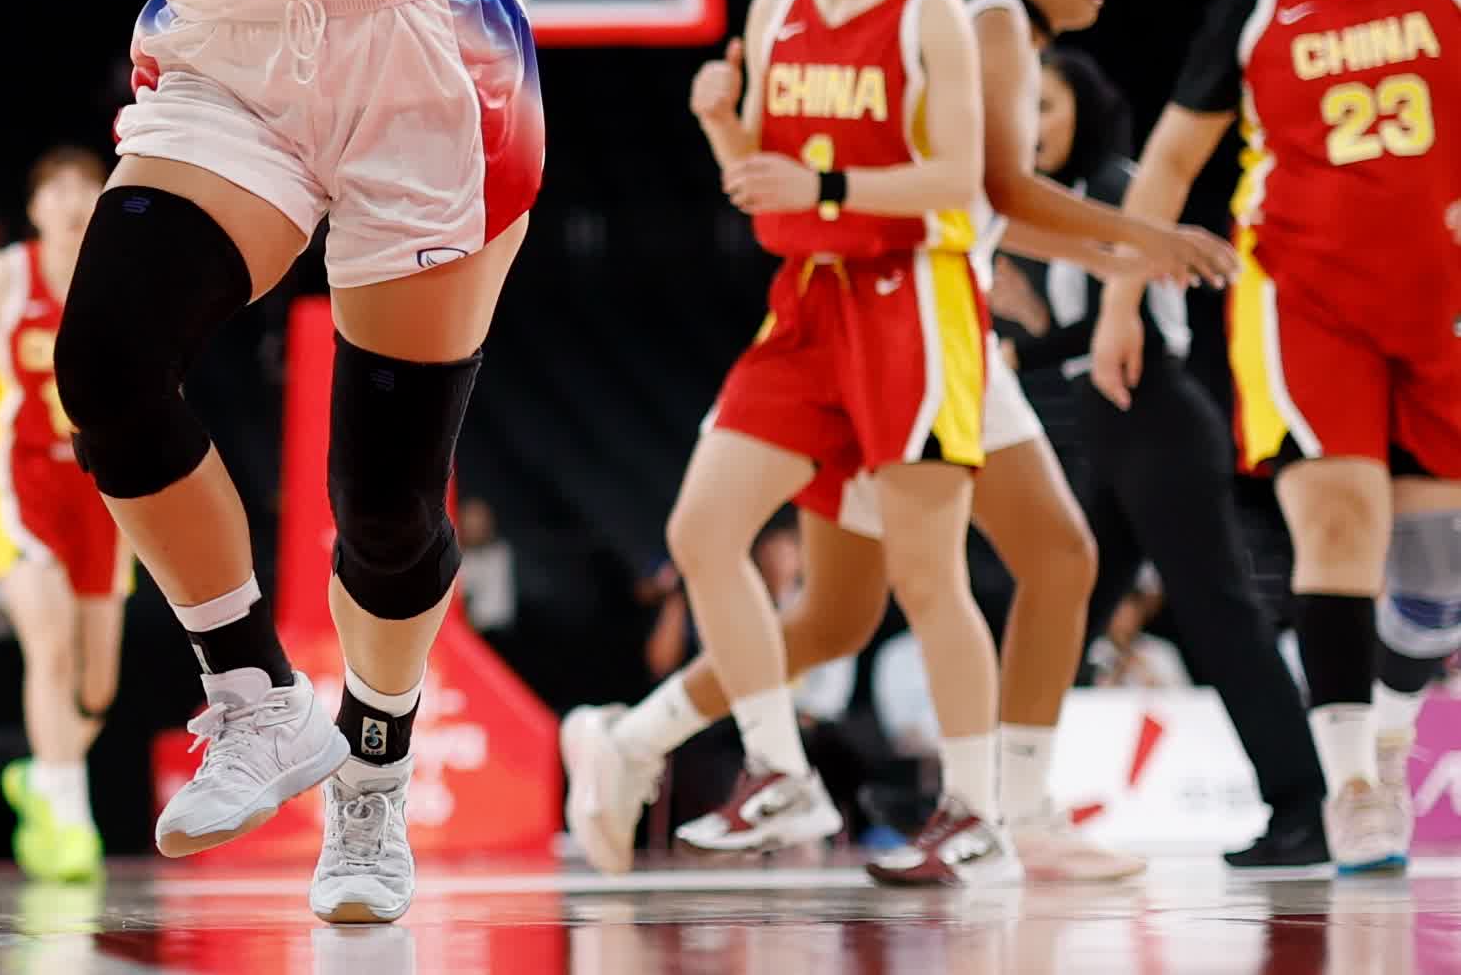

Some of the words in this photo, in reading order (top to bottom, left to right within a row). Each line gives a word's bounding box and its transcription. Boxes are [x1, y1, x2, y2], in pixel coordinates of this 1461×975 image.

[1290, 11, 1440, 81] CHINA
[768, 63, 888, 121] CHINA
[1321, 73, 1435, 166] 23
